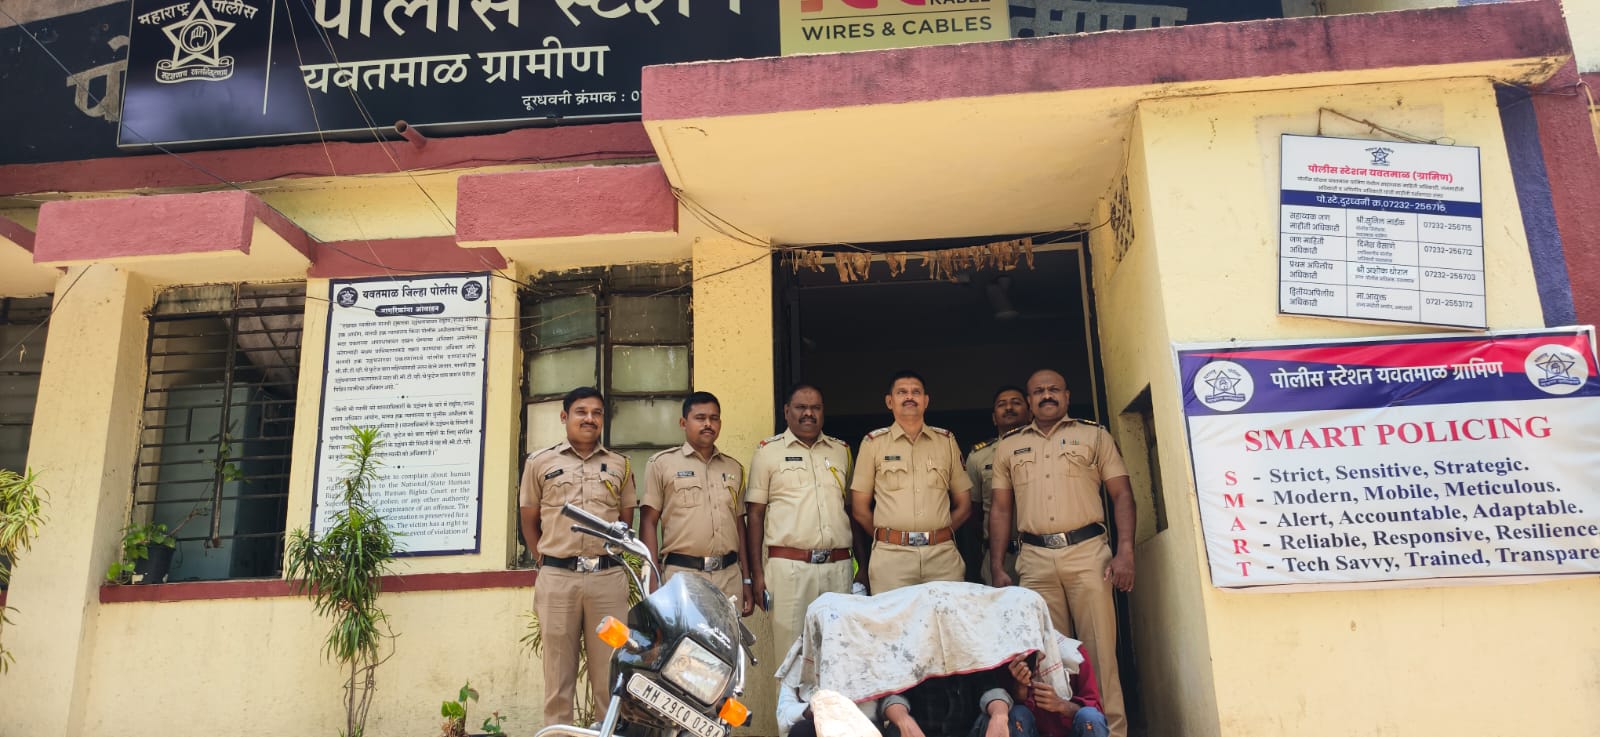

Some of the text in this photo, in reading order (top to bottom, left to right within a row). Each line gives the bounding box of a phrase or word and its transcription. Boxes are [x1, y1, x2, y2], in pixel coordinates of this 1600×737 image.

[138, 2, 190, 25] महाराष्ट्र
[802, 22, 875, 41] WIRES
[881, 21, 896, 37] &
[902, 16, 992, 35] CABLES
[299, 36, 611, 94] यवतमाळ ग्रामीण
[1308, 163, 1338, 174] पोलीस
[1339, 166, 1367, 176] स्टेशन
[1369, 168, 1410, 179] यवतमाळ
[362, 283, 458, 300] यवतमाळ जिल्हा पोलीस
[1270, 357, 1503, 389] पोलीस स्टेशन यवतमाळ ग्रामिण
[1244, 416, 1552, 452] SMART POLICING
[1224, 470, 1238, 487] S
[1269, 467, 1330, 484] Strict,
[1335, 462, 1429, 481] Sensitive,
[1433, 457, 1529, 476] Strategic.
[1223, 493, 1246, 509] M
[1272, 489, 1359, 506] Modern,
[1363, 483, 1439, 501] Mobile,
[1444, 479, 1561, 497] Meticulous.
[1230, 516, 1246, 532] A
[1277, 512, 1334, 529] Alert,
[1338, 505, 1468, 526] Accountable,
[1472, 500, 1584, 520] Adaptable.
[1232, 538, 1250, 555] R
[1280, 533, 1367, 551] Reliable,
[1373, 527, 1491, 548] Responsive,
[1236, 561, 1251, 577] T
[1282, 556, 1329, 573] Tech
[1335, 555, 1400, 573] Savvy,
[1404, 549, 1491, 568] Trained,
[642, 684, 660, 704] MH
